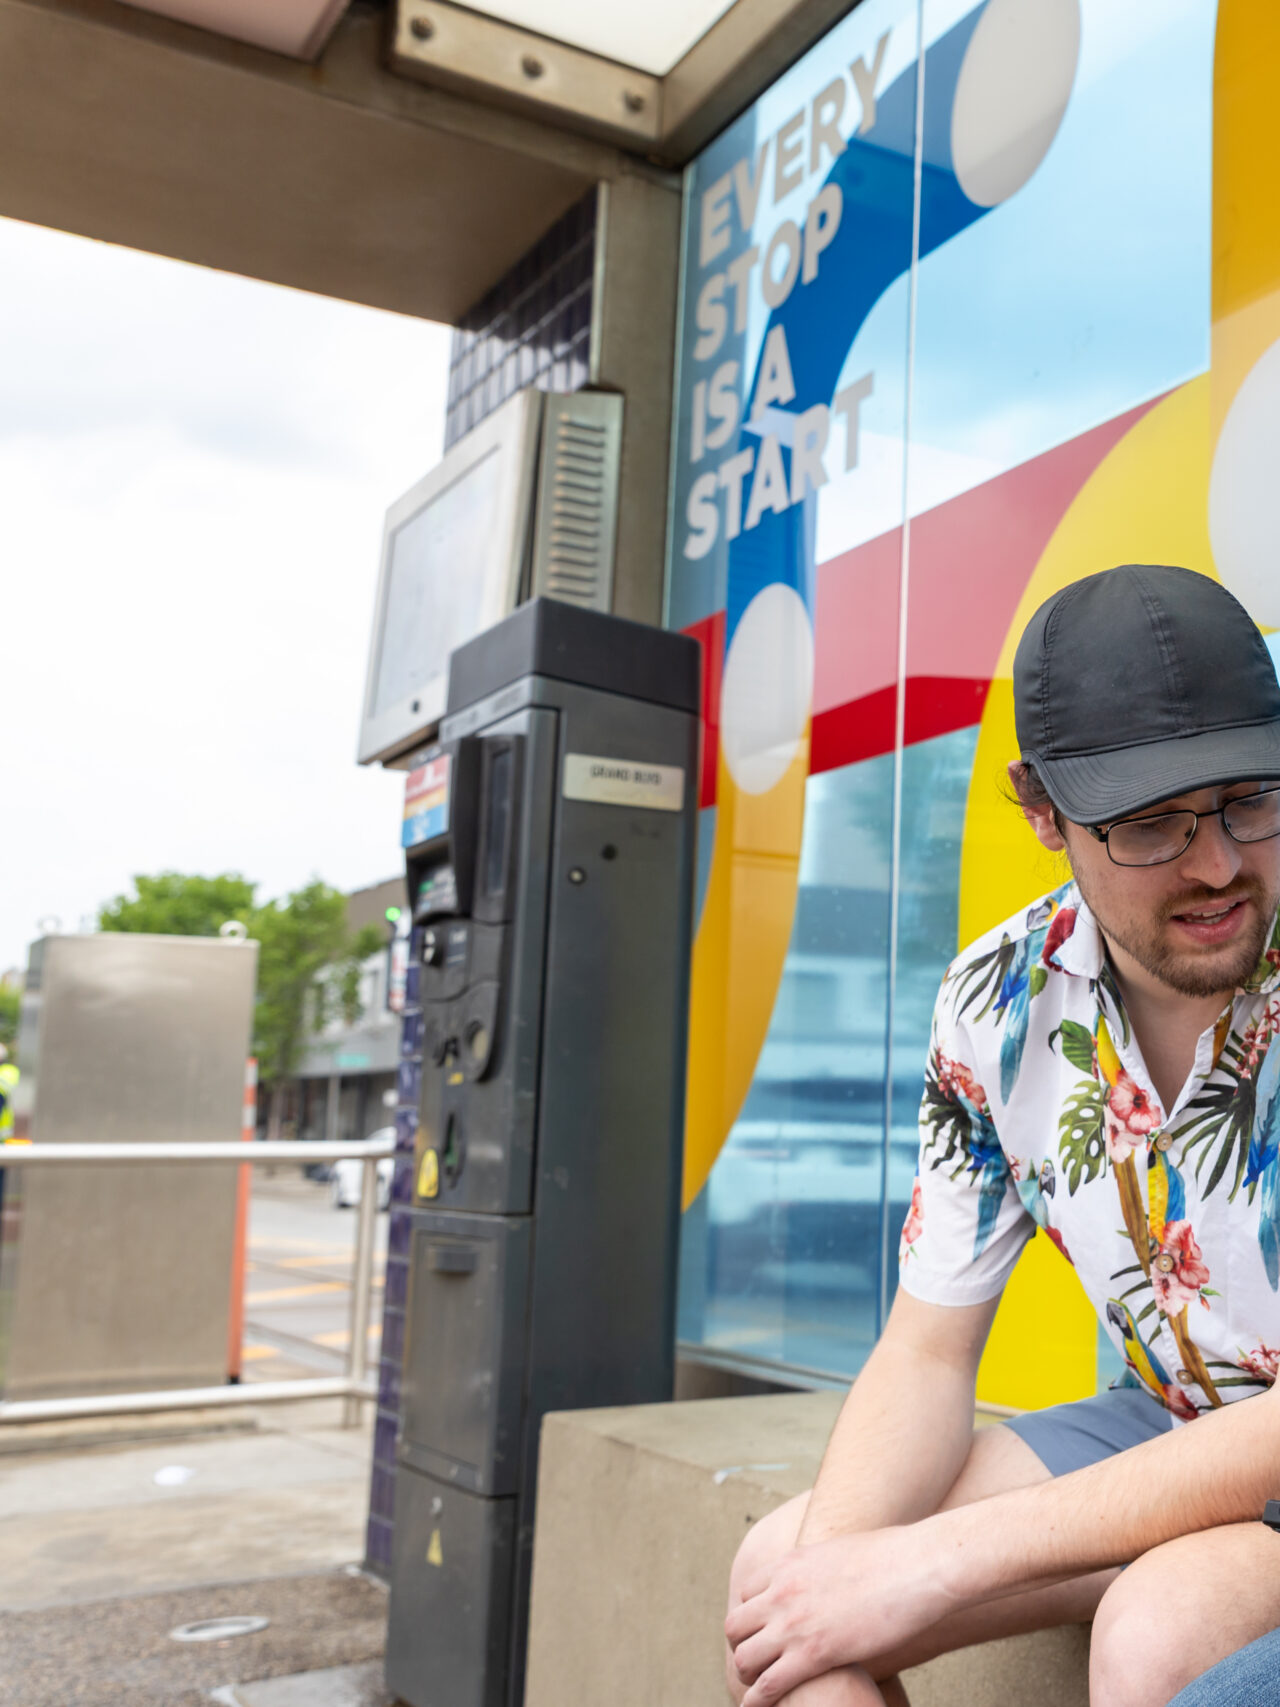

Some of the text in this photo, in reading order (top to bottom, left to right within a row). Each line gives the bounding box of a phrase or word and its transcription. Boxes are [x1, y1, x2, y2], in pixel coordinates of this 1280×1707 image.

[700, 27, 893, 267] EVERY
[693, 183, 843, 360] STOP
[684, 370, 874, 560] START
[690, 324, 796, 463] IS A
[591, 764, 629, 784] GRAND
